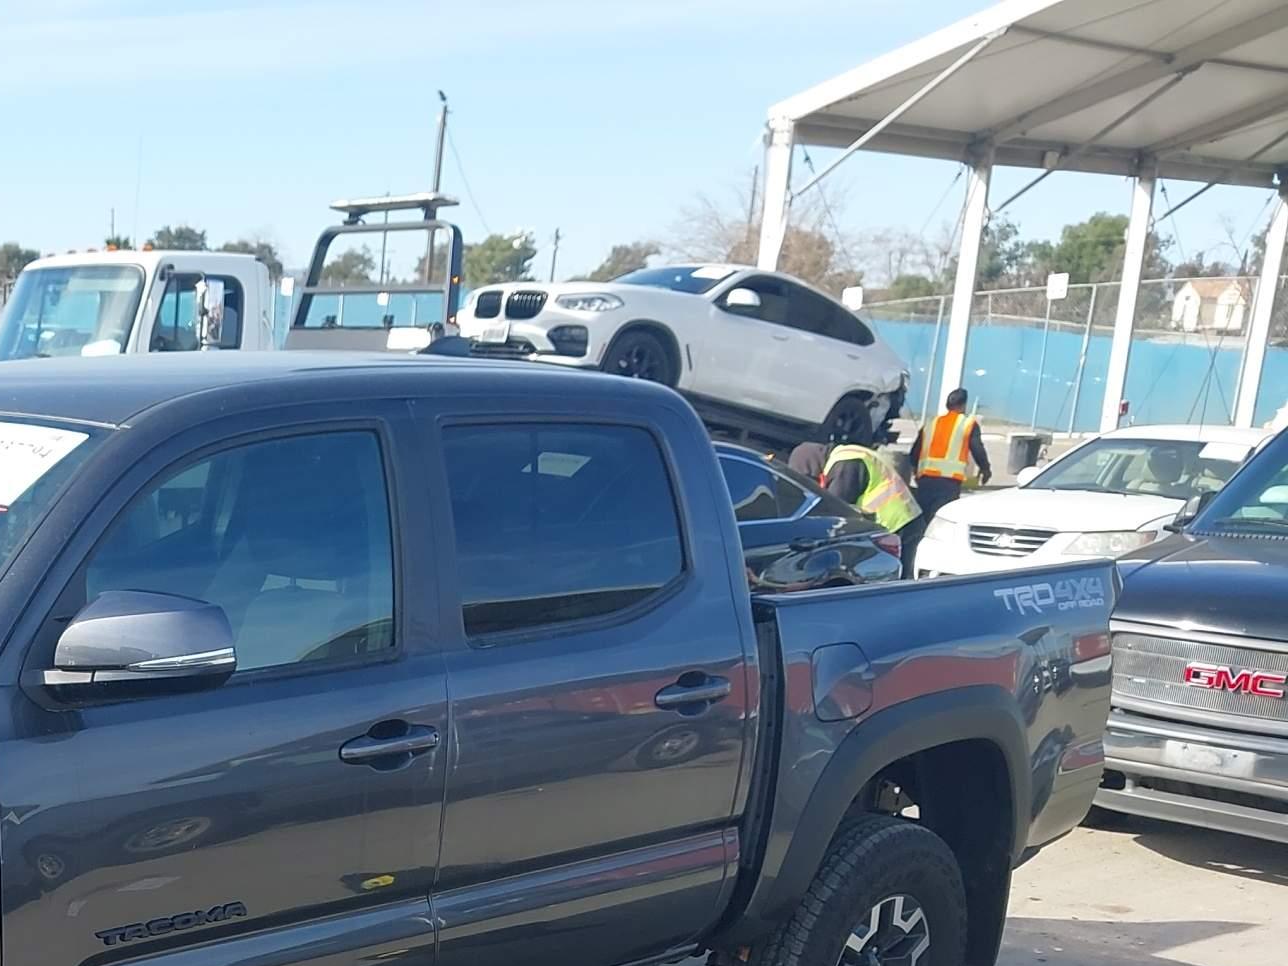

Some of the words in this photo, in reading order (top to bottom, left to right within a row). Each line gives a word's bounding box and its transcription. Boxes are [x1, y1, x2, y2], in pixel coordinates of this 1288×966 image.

[994, 583, 1055, 615] TRD
[1054, 577, 1105, 600] 4X4
[1058, 600, 1077, 611] OFF
[1078, 597, 1105, 608] ROAD
[1184, 662, 1286, 698] GMC
[94, 901, 248, 946] TACOMA
